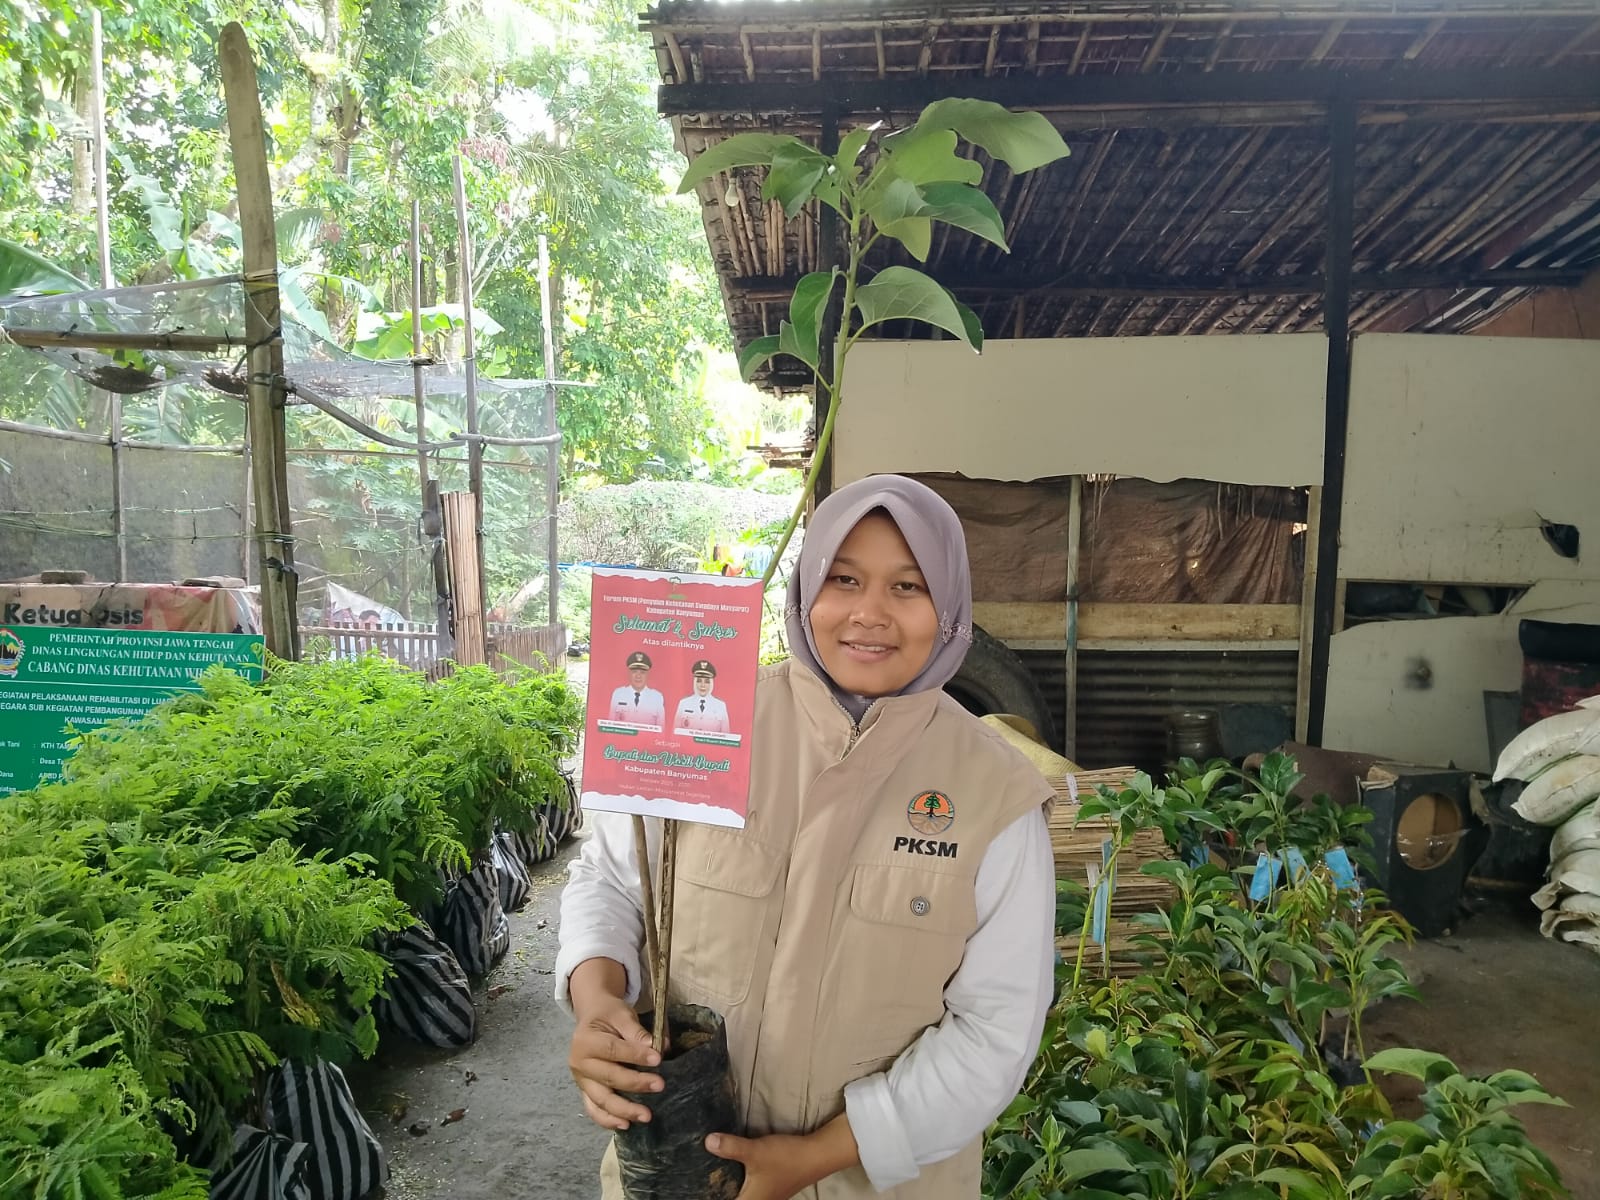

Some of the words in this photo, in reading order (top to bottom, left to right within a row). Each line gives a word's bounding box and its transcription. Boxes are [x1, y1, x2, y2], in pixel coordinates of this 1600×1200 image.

[4, 603, 81, 625] Ketua
[614, 615, 674, 634] Selamat
[689, 621, 738, 641] Sukses
[49, 633, 114, 645] PEMERINTAH
[116, 636, 162, 647] PROVINSI
[164, 638, 191, 648] JAWA
[193, 639, 234, 649] TENGAH
[643, 638, 660, 646] Atas
[661, 639, 705, 650] dilantiknya
[32, 645, 62, 656] DINAS
[64, 648, 130, 659] LINGKUNGAN
[132, 650, 163, 660] HIDUP
[165, 652, 186, 660] DAN
[188, 652, 250, 663] KEHUTANAN
[28, 661, 75, 675] CABANG
[77, 663, 110, 675] DINAS
[113, 665, 182, 678] KEHUTANAN
[31, 692, 88, 702] PELAKSANAAN
[89, 695, 141, 704] REHABILITASI
[142, 697, 150, 705] DI
[28, 703, 44, 711] SUB
[46, 704, 83, 713] KEGIATAN
[85, 706, 144, 715] PEMBANGUNAN
[639, 750, 658, 763] dan
[694, 755, 730, 773] Bupati
[624, 765, 666, 775] Kabupaten
[667, 769, 708, 781] Banyumas
[893, 836, 958, 858] PKSM
